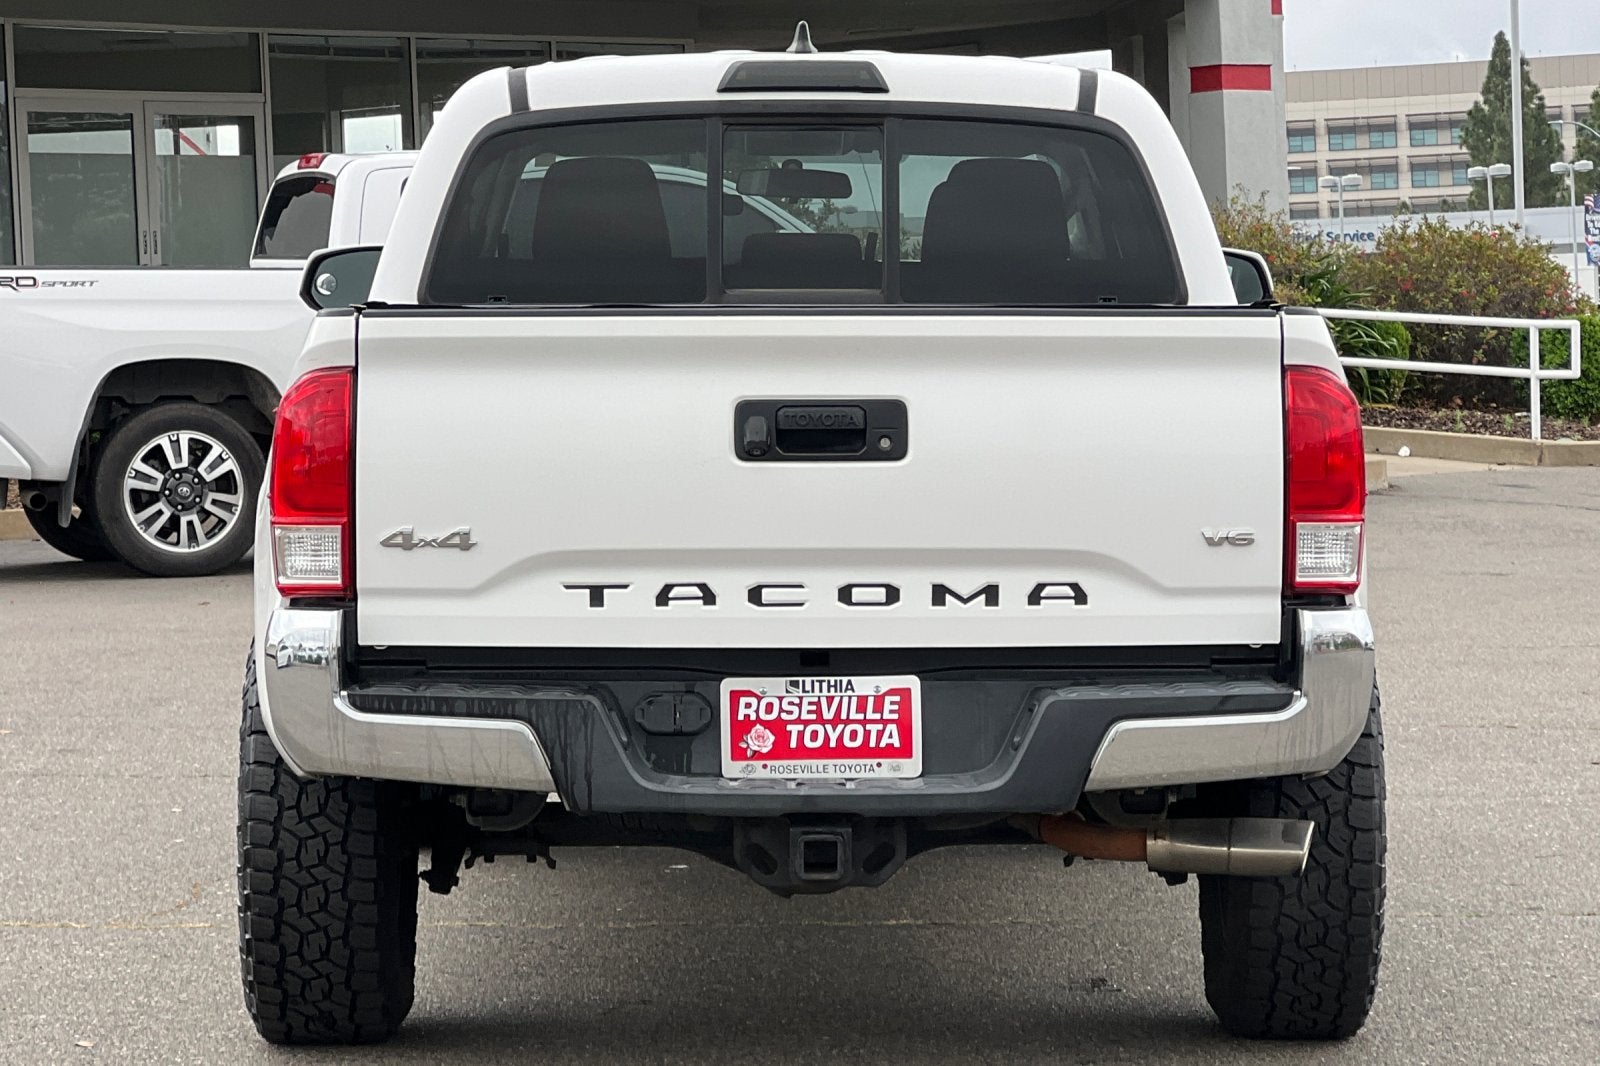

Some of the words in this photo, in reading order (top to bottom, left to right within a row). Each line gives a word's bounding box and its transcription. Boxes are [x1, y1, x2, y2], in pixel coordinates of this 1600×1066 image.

[1326, 230, 1375, 242] Service
[41, 279, 99, 288] SPORT
[784, 413, 860, 428] TOYOTA
[379, 525, 477, 551] 4x4
[1201, 528, 1255, 547] V6
[560, 581, 1089, 608] TACOMA
[801, 679, 856, 694] LITHIA
[737, 695, 901, 721] ROSEVILLE
[785, 723, 901, 749] TOYOTA
[769, 764, 830, 775] ROSEVILLE
[832, 763, 875, 774] TOYOTA
